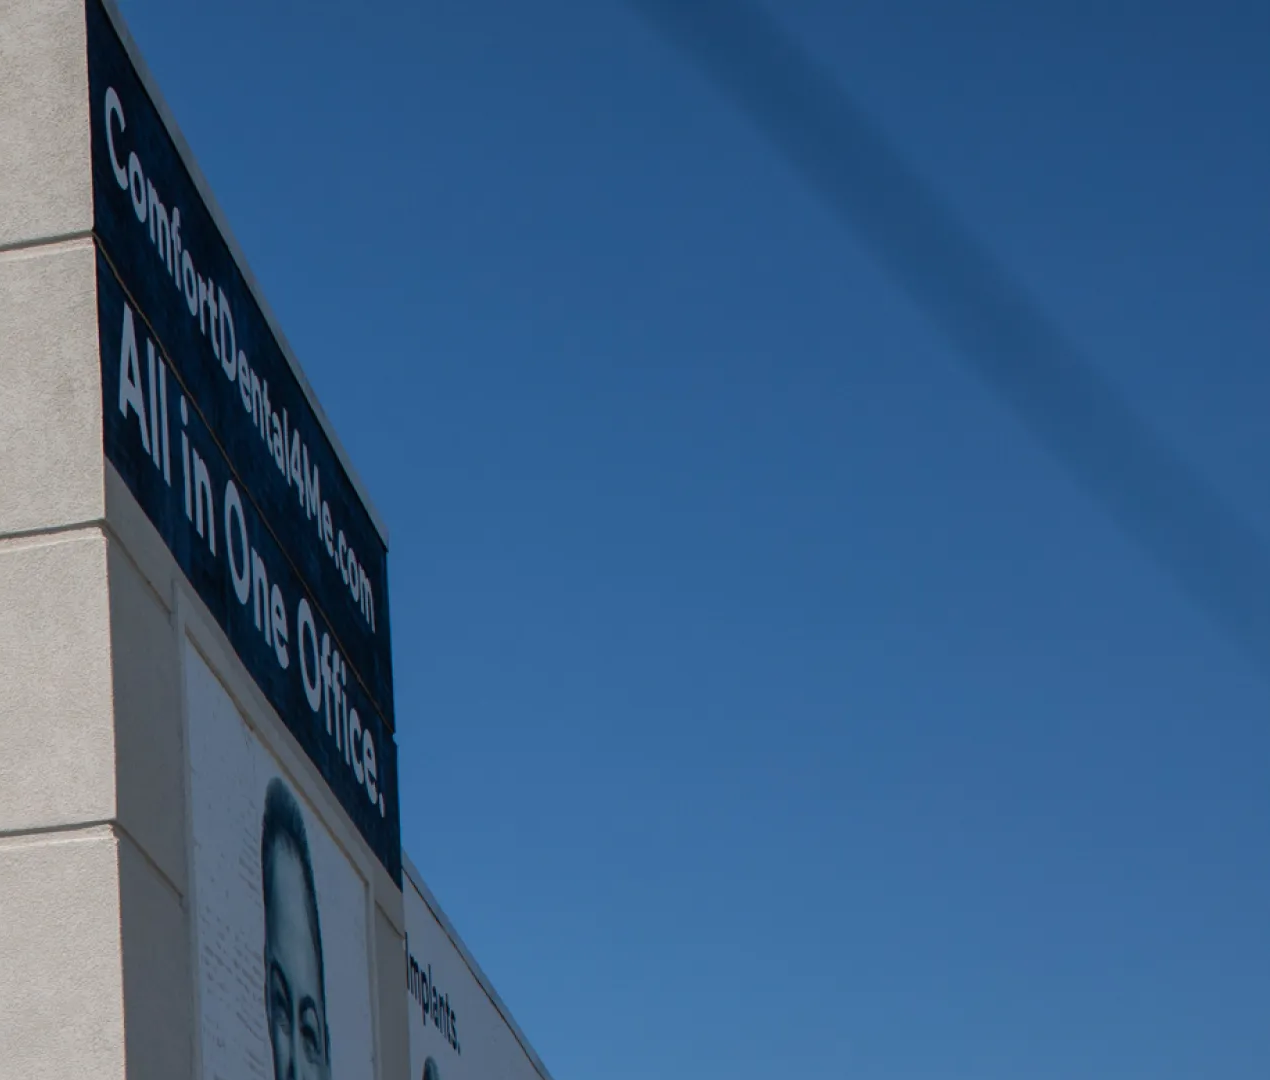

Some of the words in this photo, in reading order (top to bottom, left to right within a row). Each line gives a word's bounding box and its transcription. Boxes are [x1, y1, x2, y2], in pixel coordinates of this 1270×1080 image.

[105, 86, 376, 633] ComfortDental4Me.com
[118, 301, 172, 488] All
[180, 394, 217, 557] in
[224, 479, 289, 669] One
[297, 597, 386, 818] Office.
[404, 931, 461, 1056] Implants.
